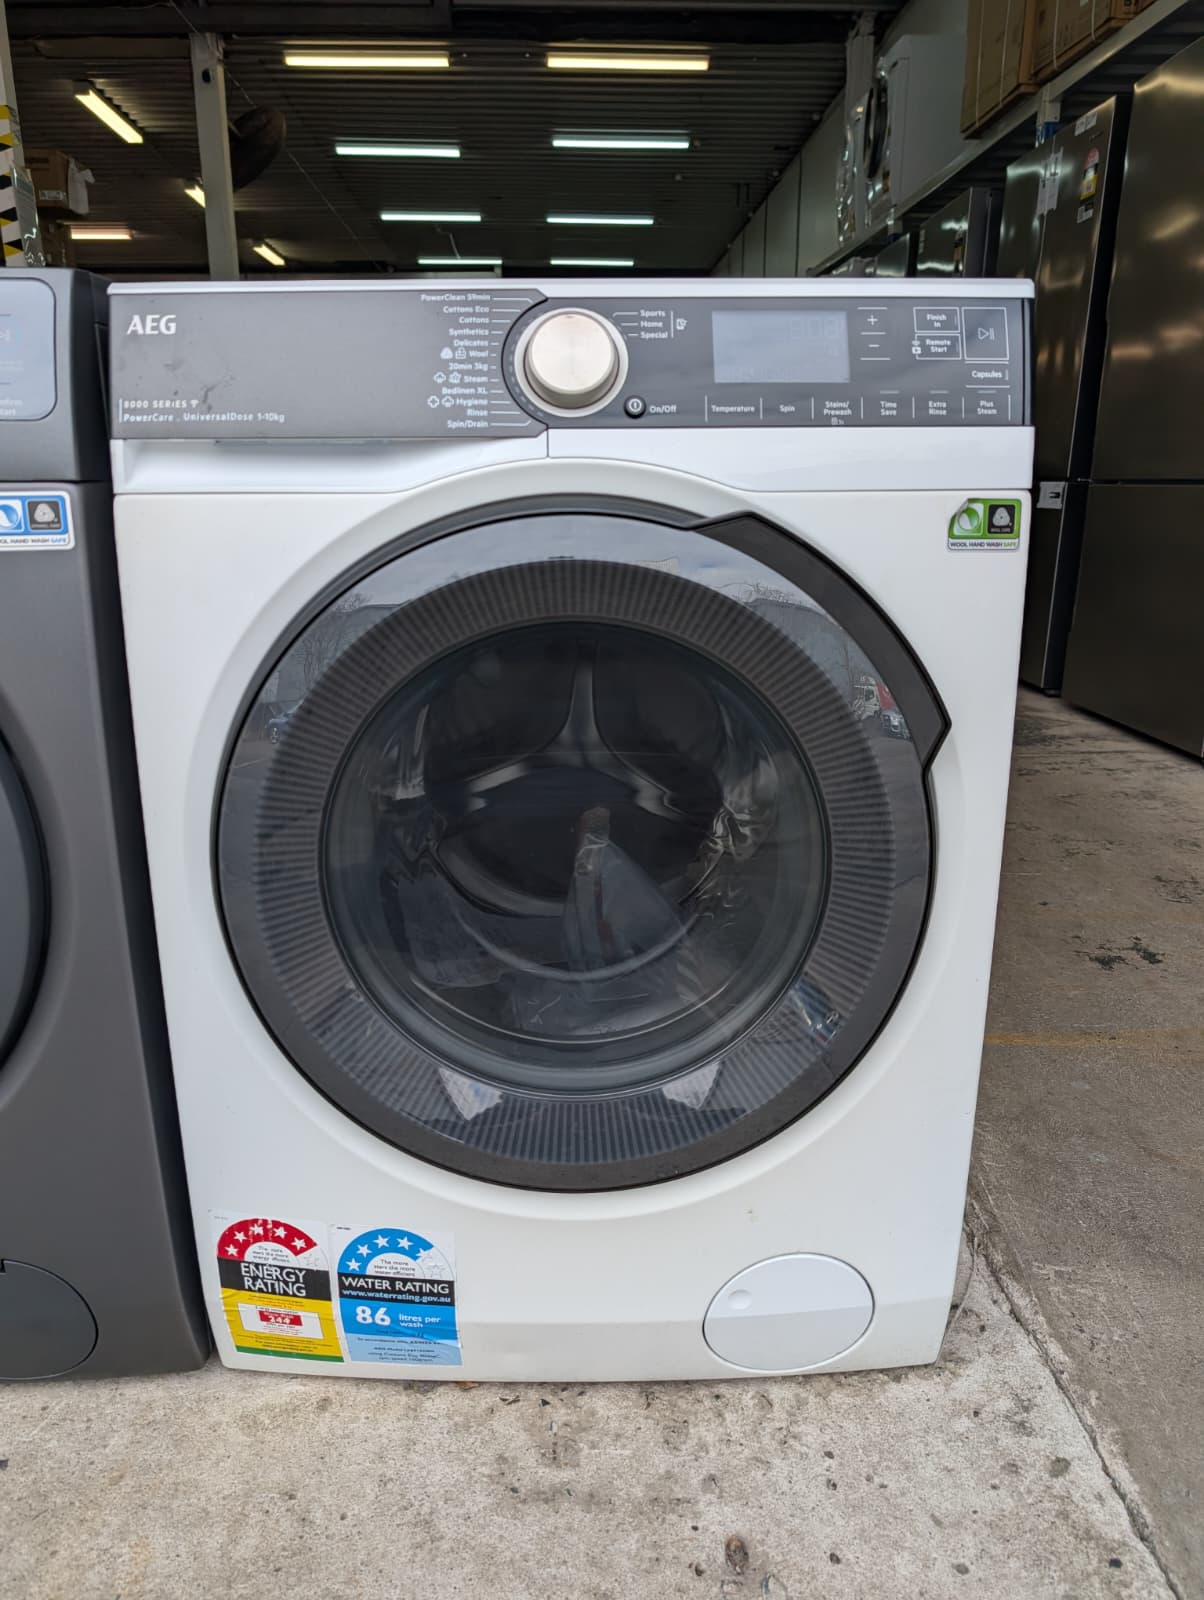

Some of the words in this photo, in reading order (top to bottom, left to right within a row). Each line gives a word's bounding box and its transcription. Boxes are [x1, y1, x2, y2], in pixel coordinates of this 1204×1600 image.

[640, 310, 666, 318] Sports
[127, 315, 176, 334] AEG
[459, 316, 489, 324] Cottons
[448, 328, 488, 336] Synthetics
[640, 332, 668, 340] Special
[449, 362, 472, 370] 20min
[474, 362, 488, 371] 3kg
[464, 375, 488, 383] Steam
[971, 370, 1002, 379] Capsules
[152, 400, 187, 408] SERIES
[456, 398, 488, 407] Hygiene
[649, 404, 677, 413] On/Off
[711, 405, 755, 413] Temperature
[779, 404, 795, 413] Spin
[823, 408, 852, 416] Prewash
[124, 413, 174, 422] PowerCare
[184, 412, 253, 421] UniversalDose
[257, 412, 285, 423] 1-10kg
[448, 420, 488, 428] Spin/Drain
[241, 1263, 306, 1283] ENERGY
[244, 1277, 306, 1297] RATING
[341, 1276, 391, 1290] WATER
[395, 1281, 449, 1294] RATING
[342, 1289, 451, 1303] www.waterrating.gov.au
[356, 1306, 391, 1326] 86
[399, 1314, 422, 1322] litres
[425, 1316, 441, 1324] per
